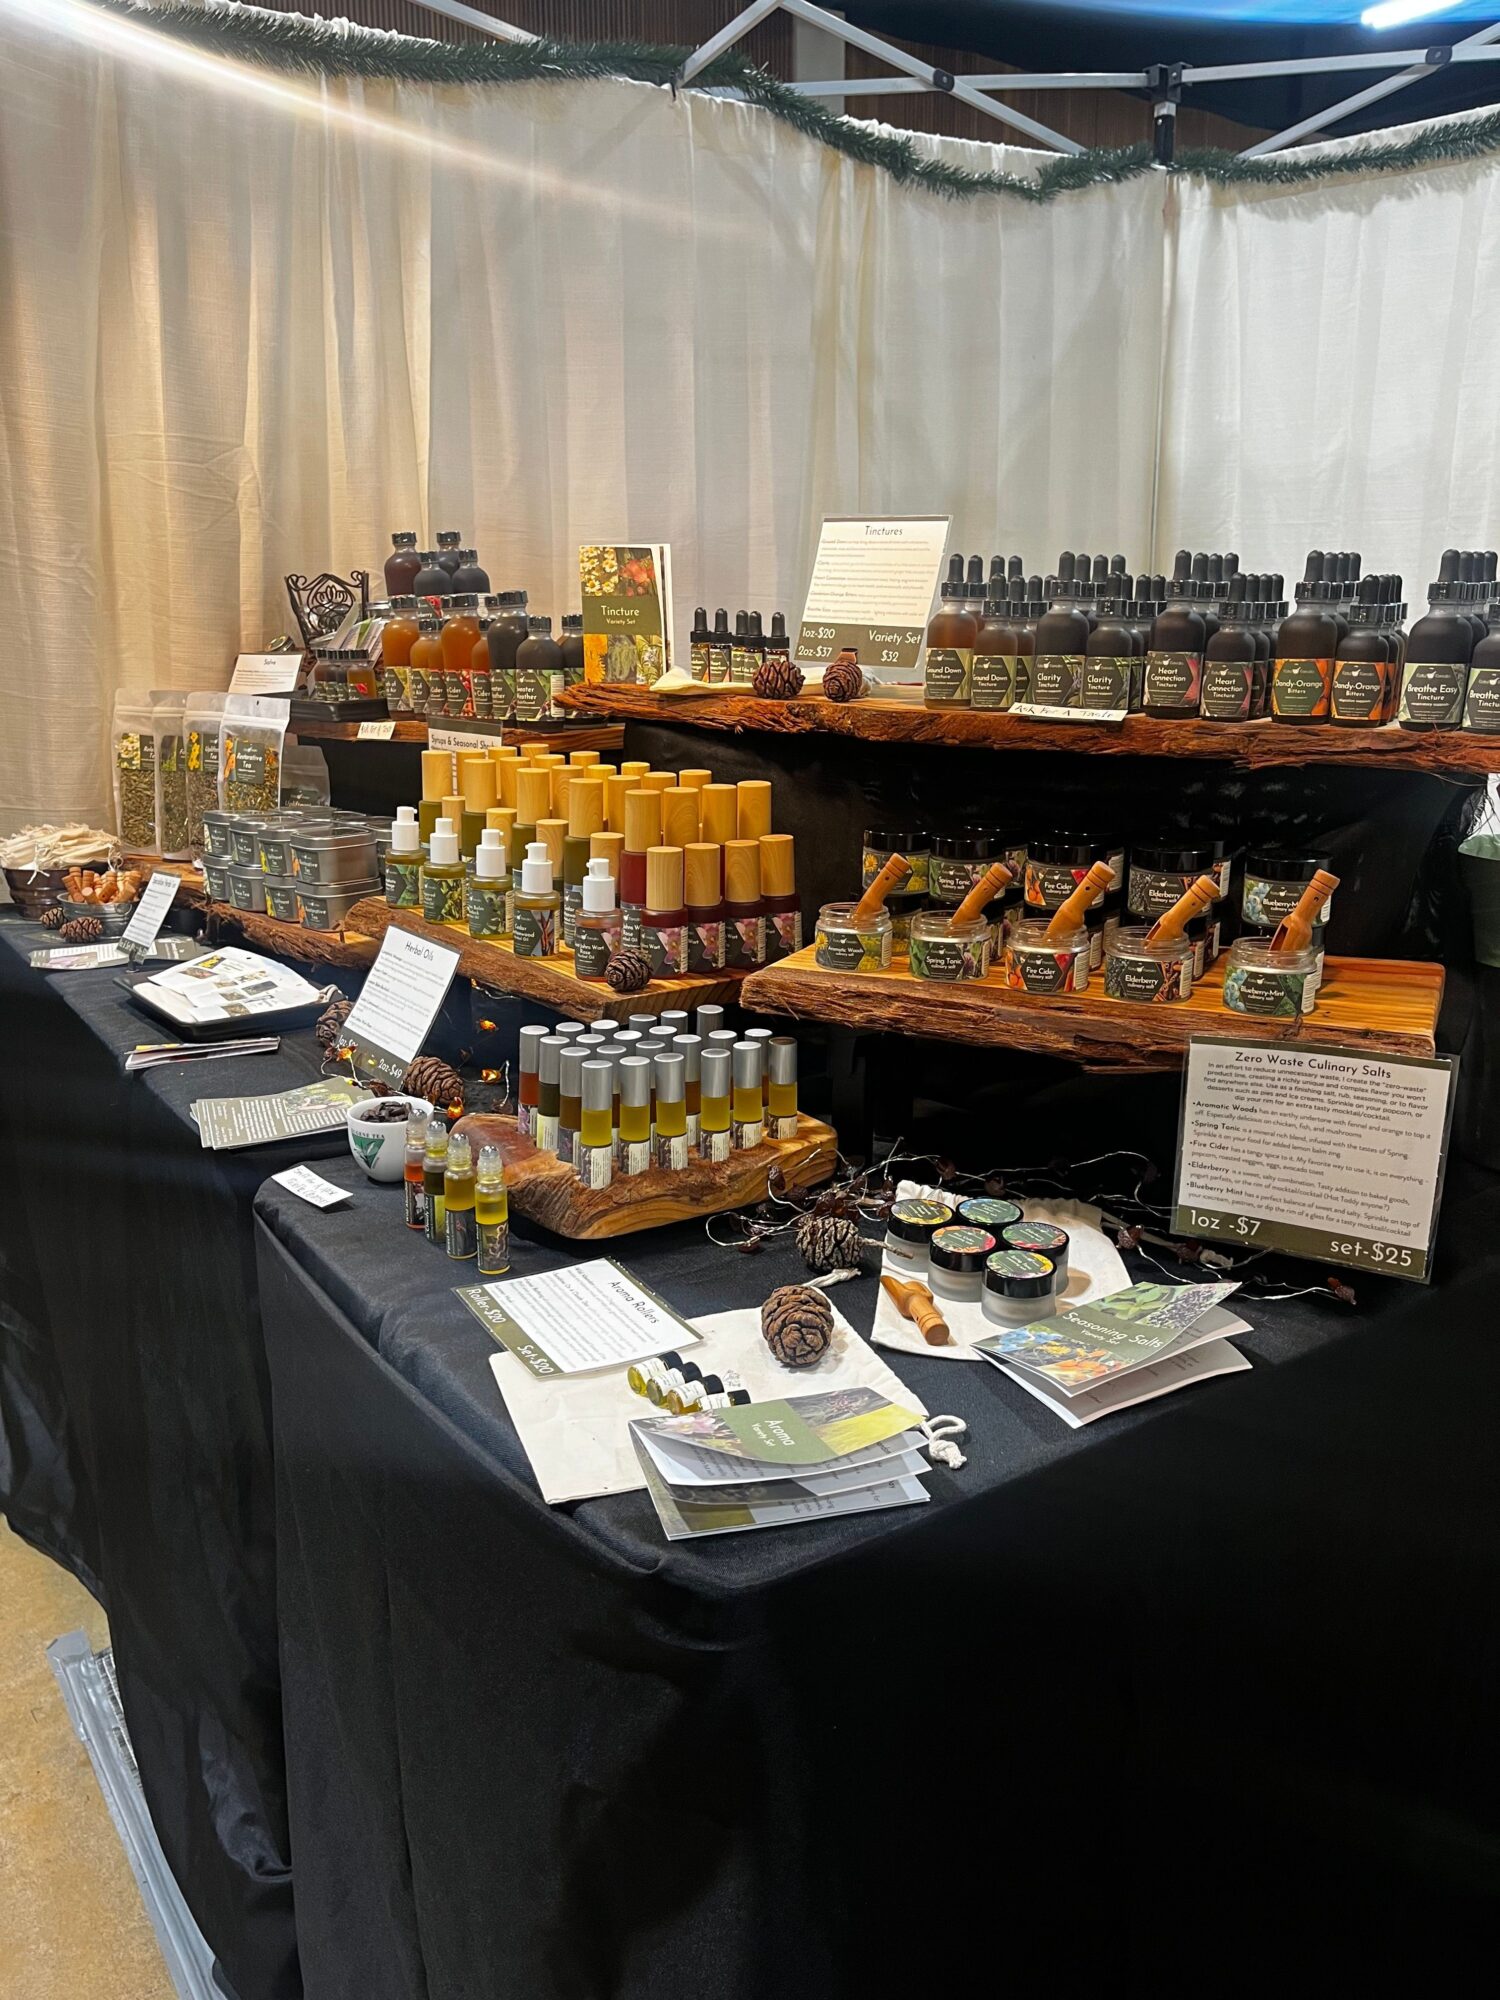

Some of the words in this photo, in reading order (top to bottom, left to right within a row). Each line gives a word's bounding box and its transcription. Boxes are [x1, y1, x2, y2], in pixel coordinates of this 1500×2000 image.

[865, 525, 903, 536] Tinctures
[601, 605, 640, 616] Tincture
[802, 627, 836, 639] 1oz-$20
[868, 630, 902, 645] Variety
[905, 632, 922, 644] Set
[798, 645, 833, 657] 2oz-$37
[881, 650, 899, 662] $32
[944, 666, 962, 674] Down
[1158, 667, 1178, 675] Heart
[990, 673, 1008, 681] Down
[1037, 672, 1061, 683] Clarity
[1087, 674, 1113, 685] Clarity
[1150, 673, 1186, 682] Connection
[1215, 677, 1236, 685] Heart
[449, 686, 461, 694] Cider
[1207, 683, 1243, 692] Connection
[1276, 679, 1323, 689] Dandy-Orange
[1407, 683, 1438, 694] Breathe
[1439, 684, 1458, 695] Easy
[1417, 693, 1445, 701] Tincture
[1469, 689, 1500, 700] Breathe
[1478, 699, 1500, 708] Tinctu
[1014, 705, 1035, 714] Ask
[1079, 710, 1113, 718] Taste
[431, 734, 447, 745] Syrups
[447, 736, 452, 746] &
[453, 737, 479, 749] Seasonal
[236, 751, 263, 762] Restorative
[242, 759, 252, 769] Tea
[938, 875, 954, 886] Spring
[955, 877, 971, 886] Tonic
[1044, 881, 1055, 890] Fire
[1055, 882, 1073, 891] Cider
[1148, 889, 1182, 900] Elderberry
[1262, 897, 1299, 909] Blueberry-M
[514, 923, 527, 931] Cedar
[405, 941, 426, 957] Herbal
[423, 948, 434, 961] Oils
[926, 955, 945, 965] Spring
[1026, 966, 1037, 974] Fire
[1038, 967, 1056, 975] Cider
[1125, 974, 1159, 986] Elderberry
[1240, 985, 1285, 998] Blueberry-Mint
[378, 1058, 403, 1078] 2oz-$49
[1235, 1051, 1262, 1063] Zero
[1266, 1053, 1304, 1067] Waste
[1307, 1057, 1358, 1075] Culinary
[1361, 1064, 1392, 1078] Salts
[1207, 1069, 1232, 1077] product
[1247, 1073, 1275, 1081] creating
[1301, 1079, 1324, 1087] unique
[1339, 1084, 1368, 1093] complex
[1370, 1088, 1390, 1096] flavor
[1277, 1069, 1317, 1078] unnecessary
[1381, 1081, 1427, 1093] "zero-waste"
[1217, 1078, 1248, 1086] anywhere
[1293, 1085, 1322, 1095] finishing
[1407, 1102, 1428, 1110] flavor
[1195, 1100, 1229, 1110] Aromatic
[1231, 1103, 1258, 1113] Woods
[1194, 1119, 1219, 1130] Spring
[1220, 1122, 1240, 1131] Tonic
[1192, 1139, 1207, 1147] Fire
[1209, 1141, 1229, 1151] Cider
[1191, 1160, 1229, 1174] Elderberry
[1189, 1181, 1223, 1194] Blueberry
[1225, 1187, 1242, 1196] Mint
[1191, 1209, 1220, 1230] 1oz
[1229, 1216, 1261, 1236] -$7
[1330, 1241, 1412, 1267] set-$25
[466, 1288, 506, 1324] Roller-$20
[608, 1281, 634, 1303] Aroma
[632, 1301, 659, 1324] Rollers
[1062, 1311, 1129, 1340] Seasoning
[1128, 1334, 1165, 1348] Salts
[1080, 1328, 1107, 1341] Variety
[517, 1344, 554, 1375] Set-$20
[751, 1422, 768, 1439] Variety
[763, 1438, 776, 1447] Set
[764, 1420, 796, 1446] Aroma
